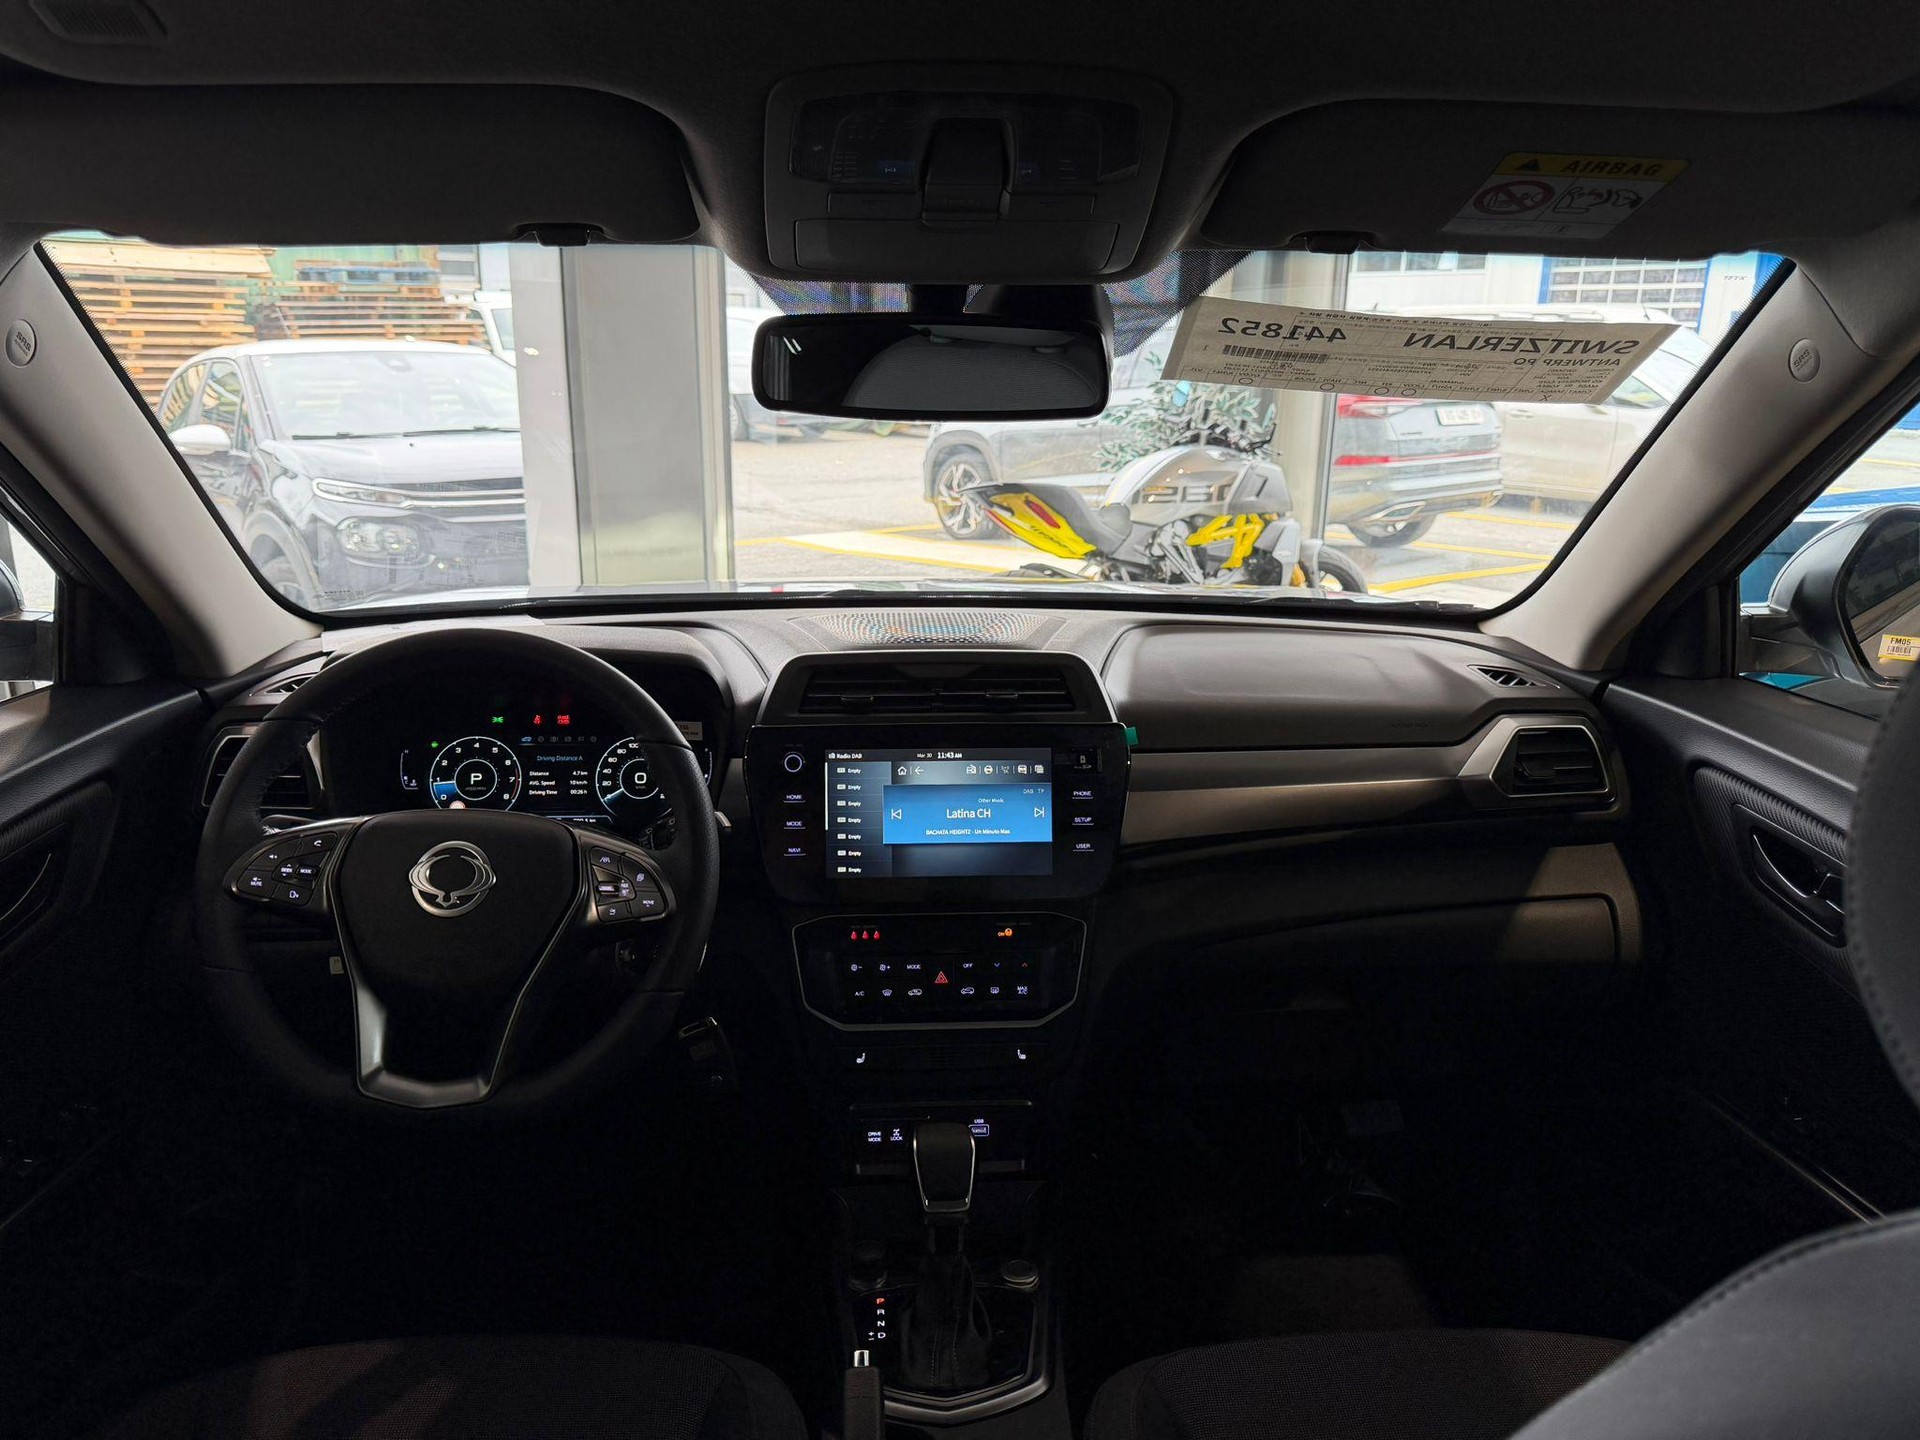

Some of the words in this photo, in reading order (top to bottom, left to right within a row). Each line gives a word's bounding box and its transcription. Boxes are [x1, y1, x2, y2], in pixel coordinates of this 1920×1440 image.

[1560, 158, 1662, 176] AIRBAG
[16, 331, 32, 352] SRS
[1793, 349, 1810, 368] SRS
[1889, 636, 1912, 646] FM05
[937, 751, 954, 759] 11:43
[470, 773, 483, 785] P
[634, 772, 647, 784] 0
[946, 808, 976, 819] Latina
[977, 808, 992, 819] CH
[926, 828, 949, 836] BACHATA
[974, 828, 982, 836] Un
[982, 828, 1000, 836] Minuto
[848, 850, 862, 858] Empty
[876, 1297, 885, 1305] P
[876, 1308, 885, 1316] R
